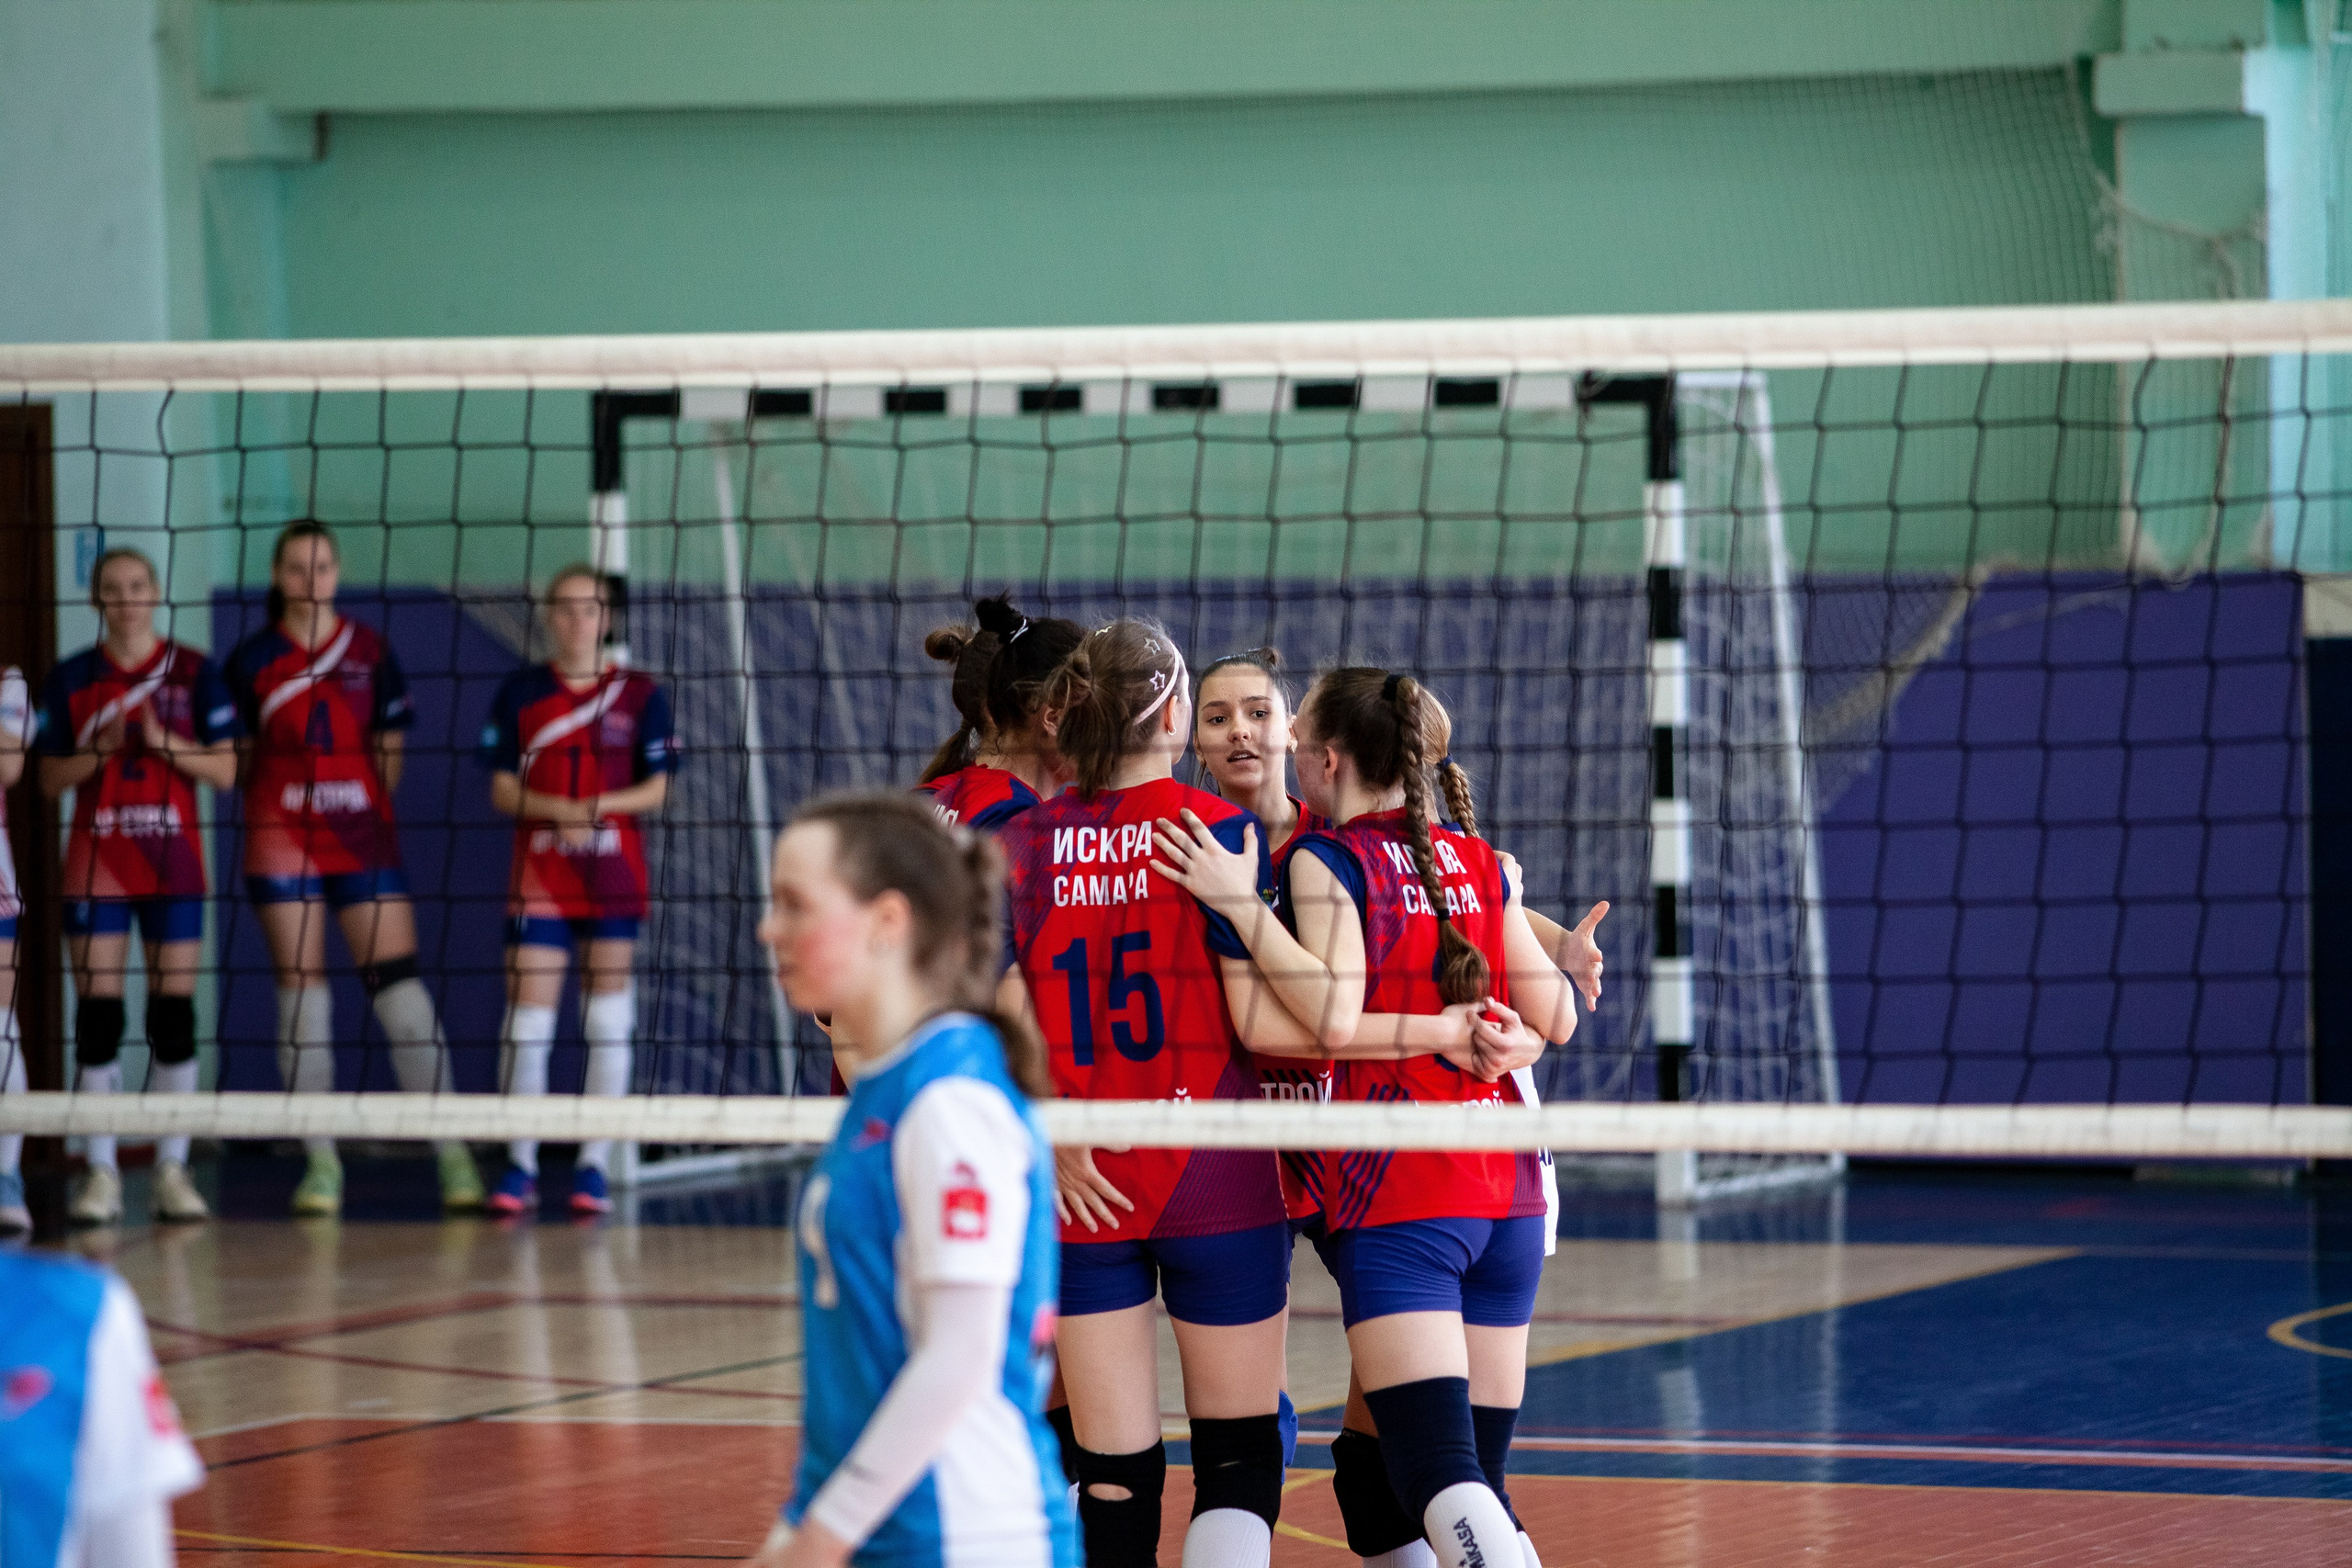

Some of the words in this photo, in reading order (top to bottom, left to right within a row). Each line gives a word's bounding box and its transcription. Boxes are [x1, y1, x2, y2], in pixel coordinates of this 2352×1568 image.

[1053, 820, 1152, 864] ИСКРА
[1382, 839, 1467, 877] ИСРА
[1402, 883, 1481, 917] СААРА
[1052, 931, 1165, 1066] 15
